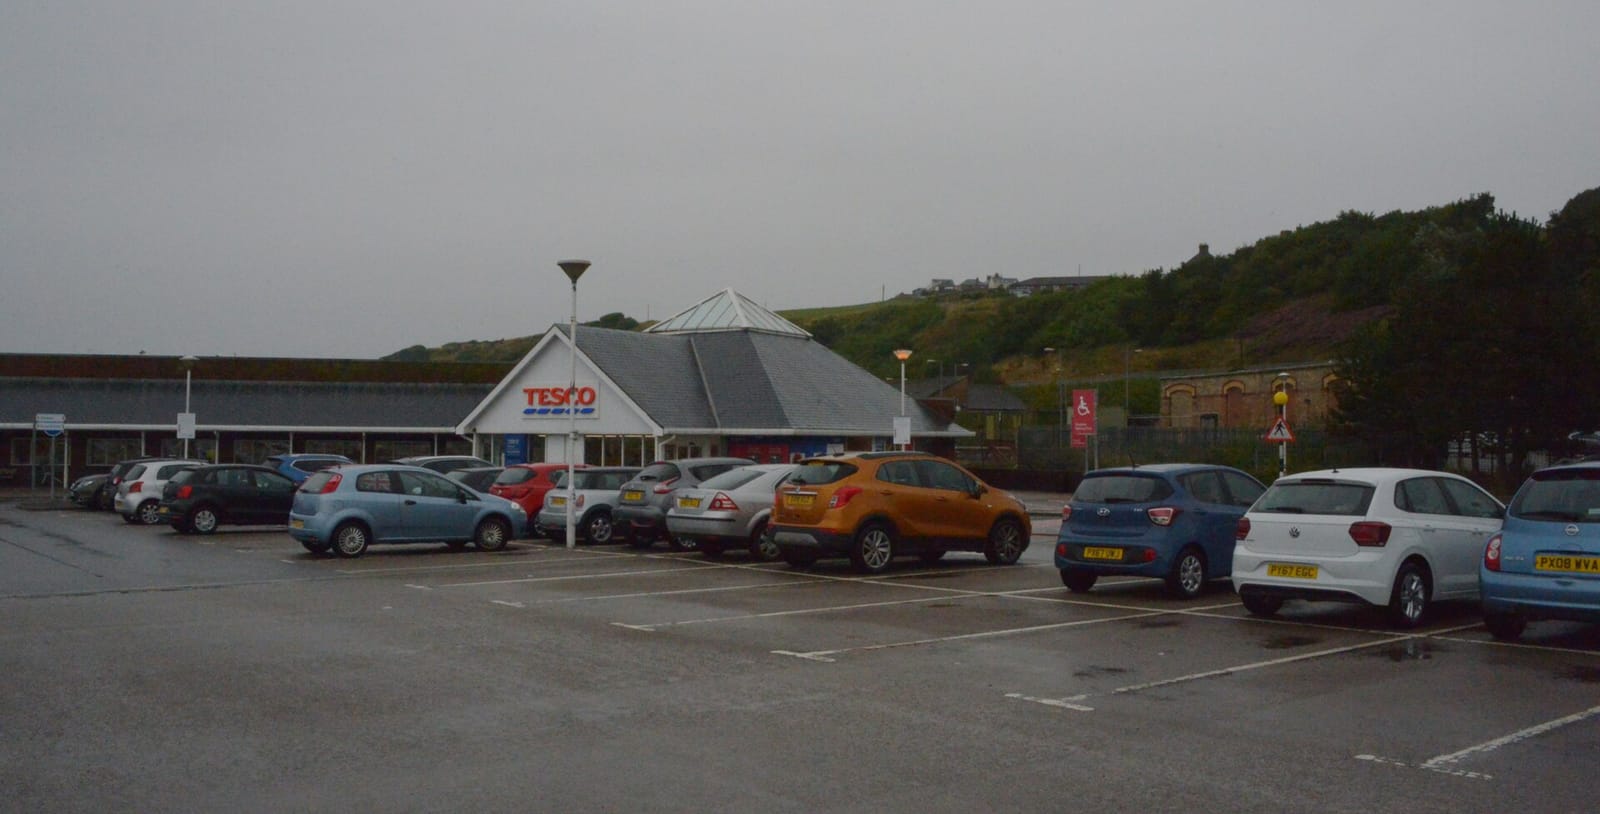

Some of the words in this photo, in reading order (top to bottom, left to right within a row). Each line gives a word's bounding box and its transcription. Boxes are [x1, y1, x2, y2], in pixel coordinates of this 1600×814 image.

[523, 386, 596, 406] TESCO
[1270, 564, 1294, 576] PY67
[1295, 566, 1315, 578] EGC
[1540, 556, 1572, 569] PX08
[1575, 558, 1599, 571] WVA
